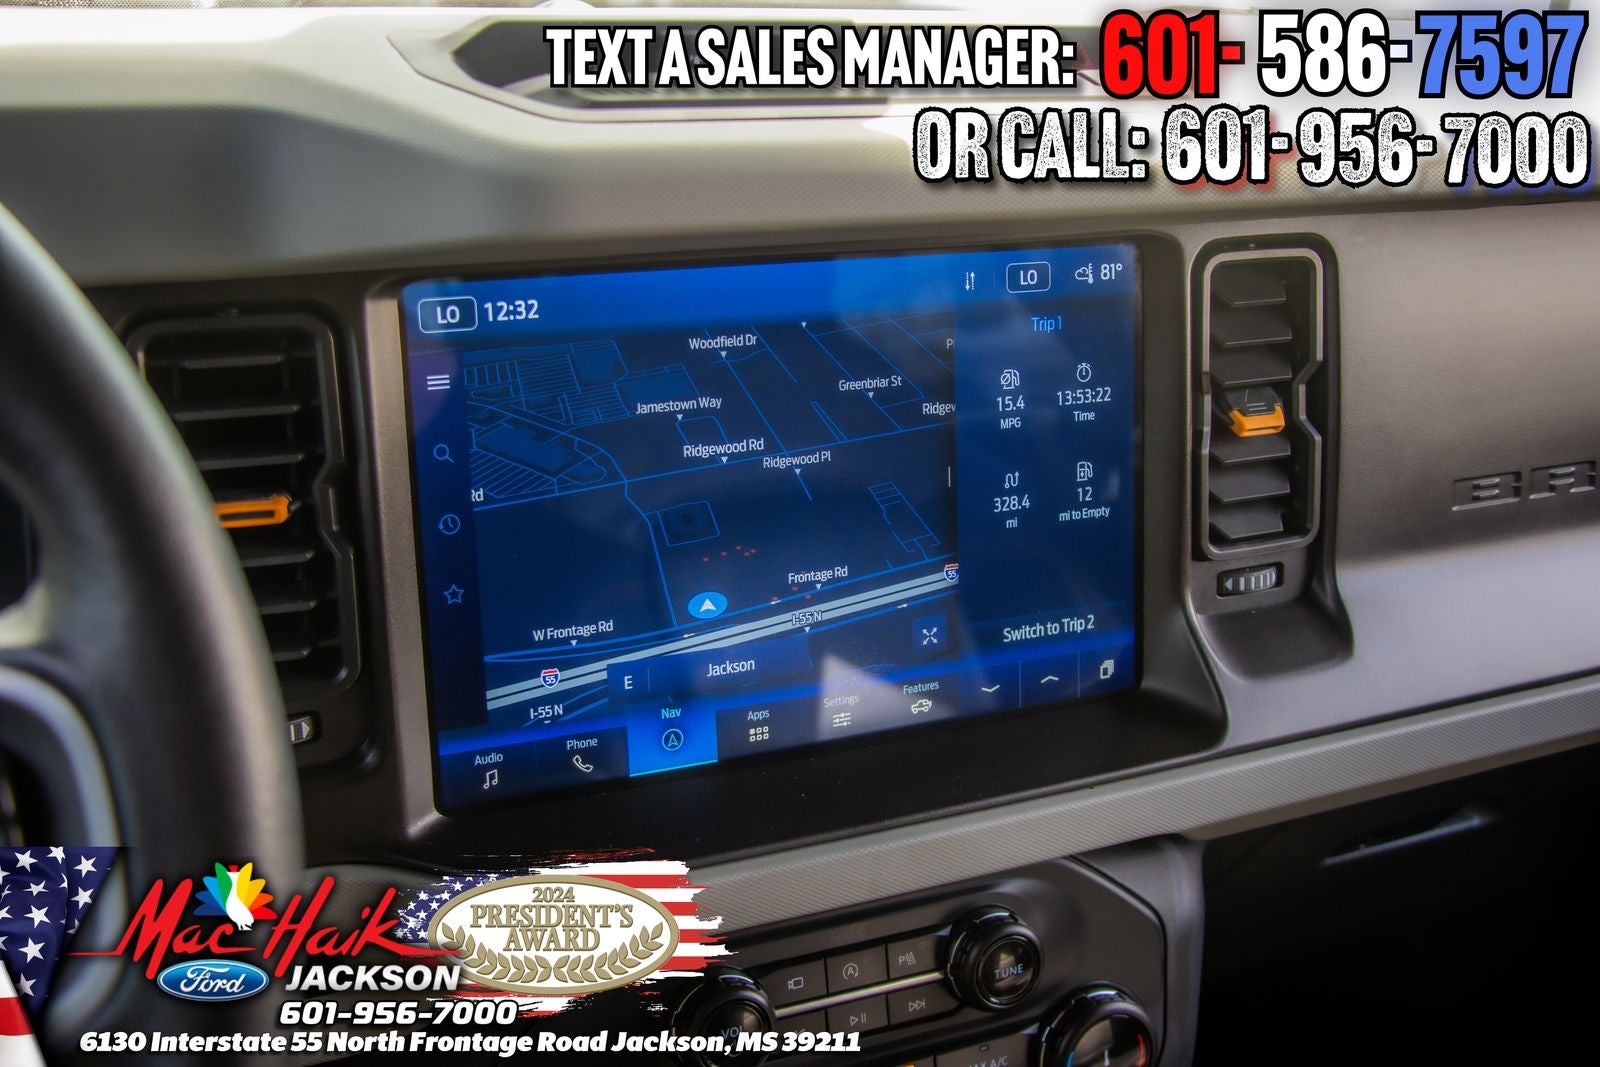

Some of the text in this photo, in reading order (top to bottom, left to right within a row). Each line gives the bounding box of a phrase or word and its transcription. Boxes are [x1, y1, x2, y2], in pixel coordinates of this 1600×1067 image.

[1020, 270, 1037, 285] LO
[436, 306, 460, 324] LO
[484, 299, 539, 321] 12:32
[1031, 315, 1063, 333] Trip 1
[689, 334, 757, 350] Woodfield Dr
[839, 375, 902, 391] Greenbriar St
[997, 396, 1025, 412] 15.4
[1057, 387, 1112, 406] 13:53:22
[635, 397, 722, 414] Jamestown Way
[1000, 418, 1021, 429] MPG
[1073, 411, 1095, 422] Time
[683, 438, 764, 458] Ridgewood Rd
[763, 451, 831, 468] Ridgewood Pl
[1077, 486, 1092, 502] 12
[994, 494, 1030, 513] 328.4
[1059, 506, 1110, 521] mi to Empty
[1006, 517, 1018, 529] mi
[788, 566, 848, 585] Frontage Rd
[792, 610, 822, 625] I-55 N
[533, 620, 614, 641] W Frontage Rd
[1003, 614, 1095, 642] Switch to Trip 2
[707, 659, 755, 677] Jackson
[624, 676, 633, 689] E
[903, 681, 939, 695] Features
[823, 694, 859, 708] Settings
[530, 704, 563, 719] I-55 N
[661, 707, 681, 720] Nav
[747, 709, 770, 721] Apps
[566, 737, 598, 751] Phone
[474, 752, 503, 766] Audio
[994, 963, 1024, 979] TUNE
